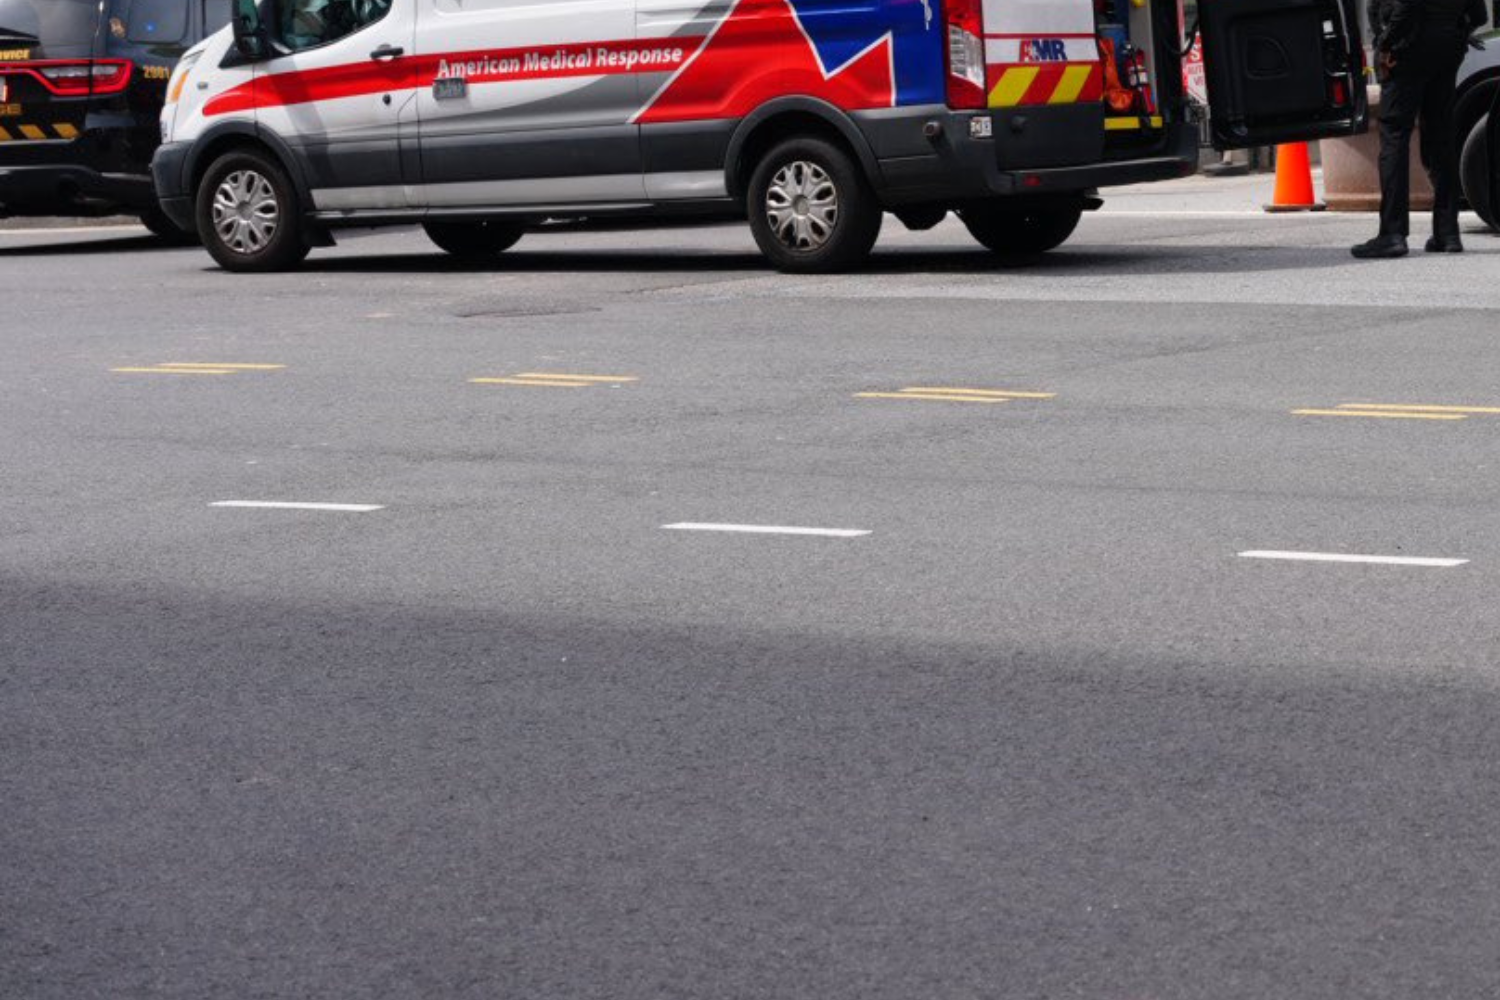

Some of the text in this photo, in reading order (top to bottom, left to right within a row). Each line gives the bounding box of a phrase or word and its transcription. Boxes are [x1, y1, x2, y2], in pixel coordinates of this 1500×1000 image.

[437, 47, 683, 79] American Medical Response
[1019, 38, 1068, 63] AMR
